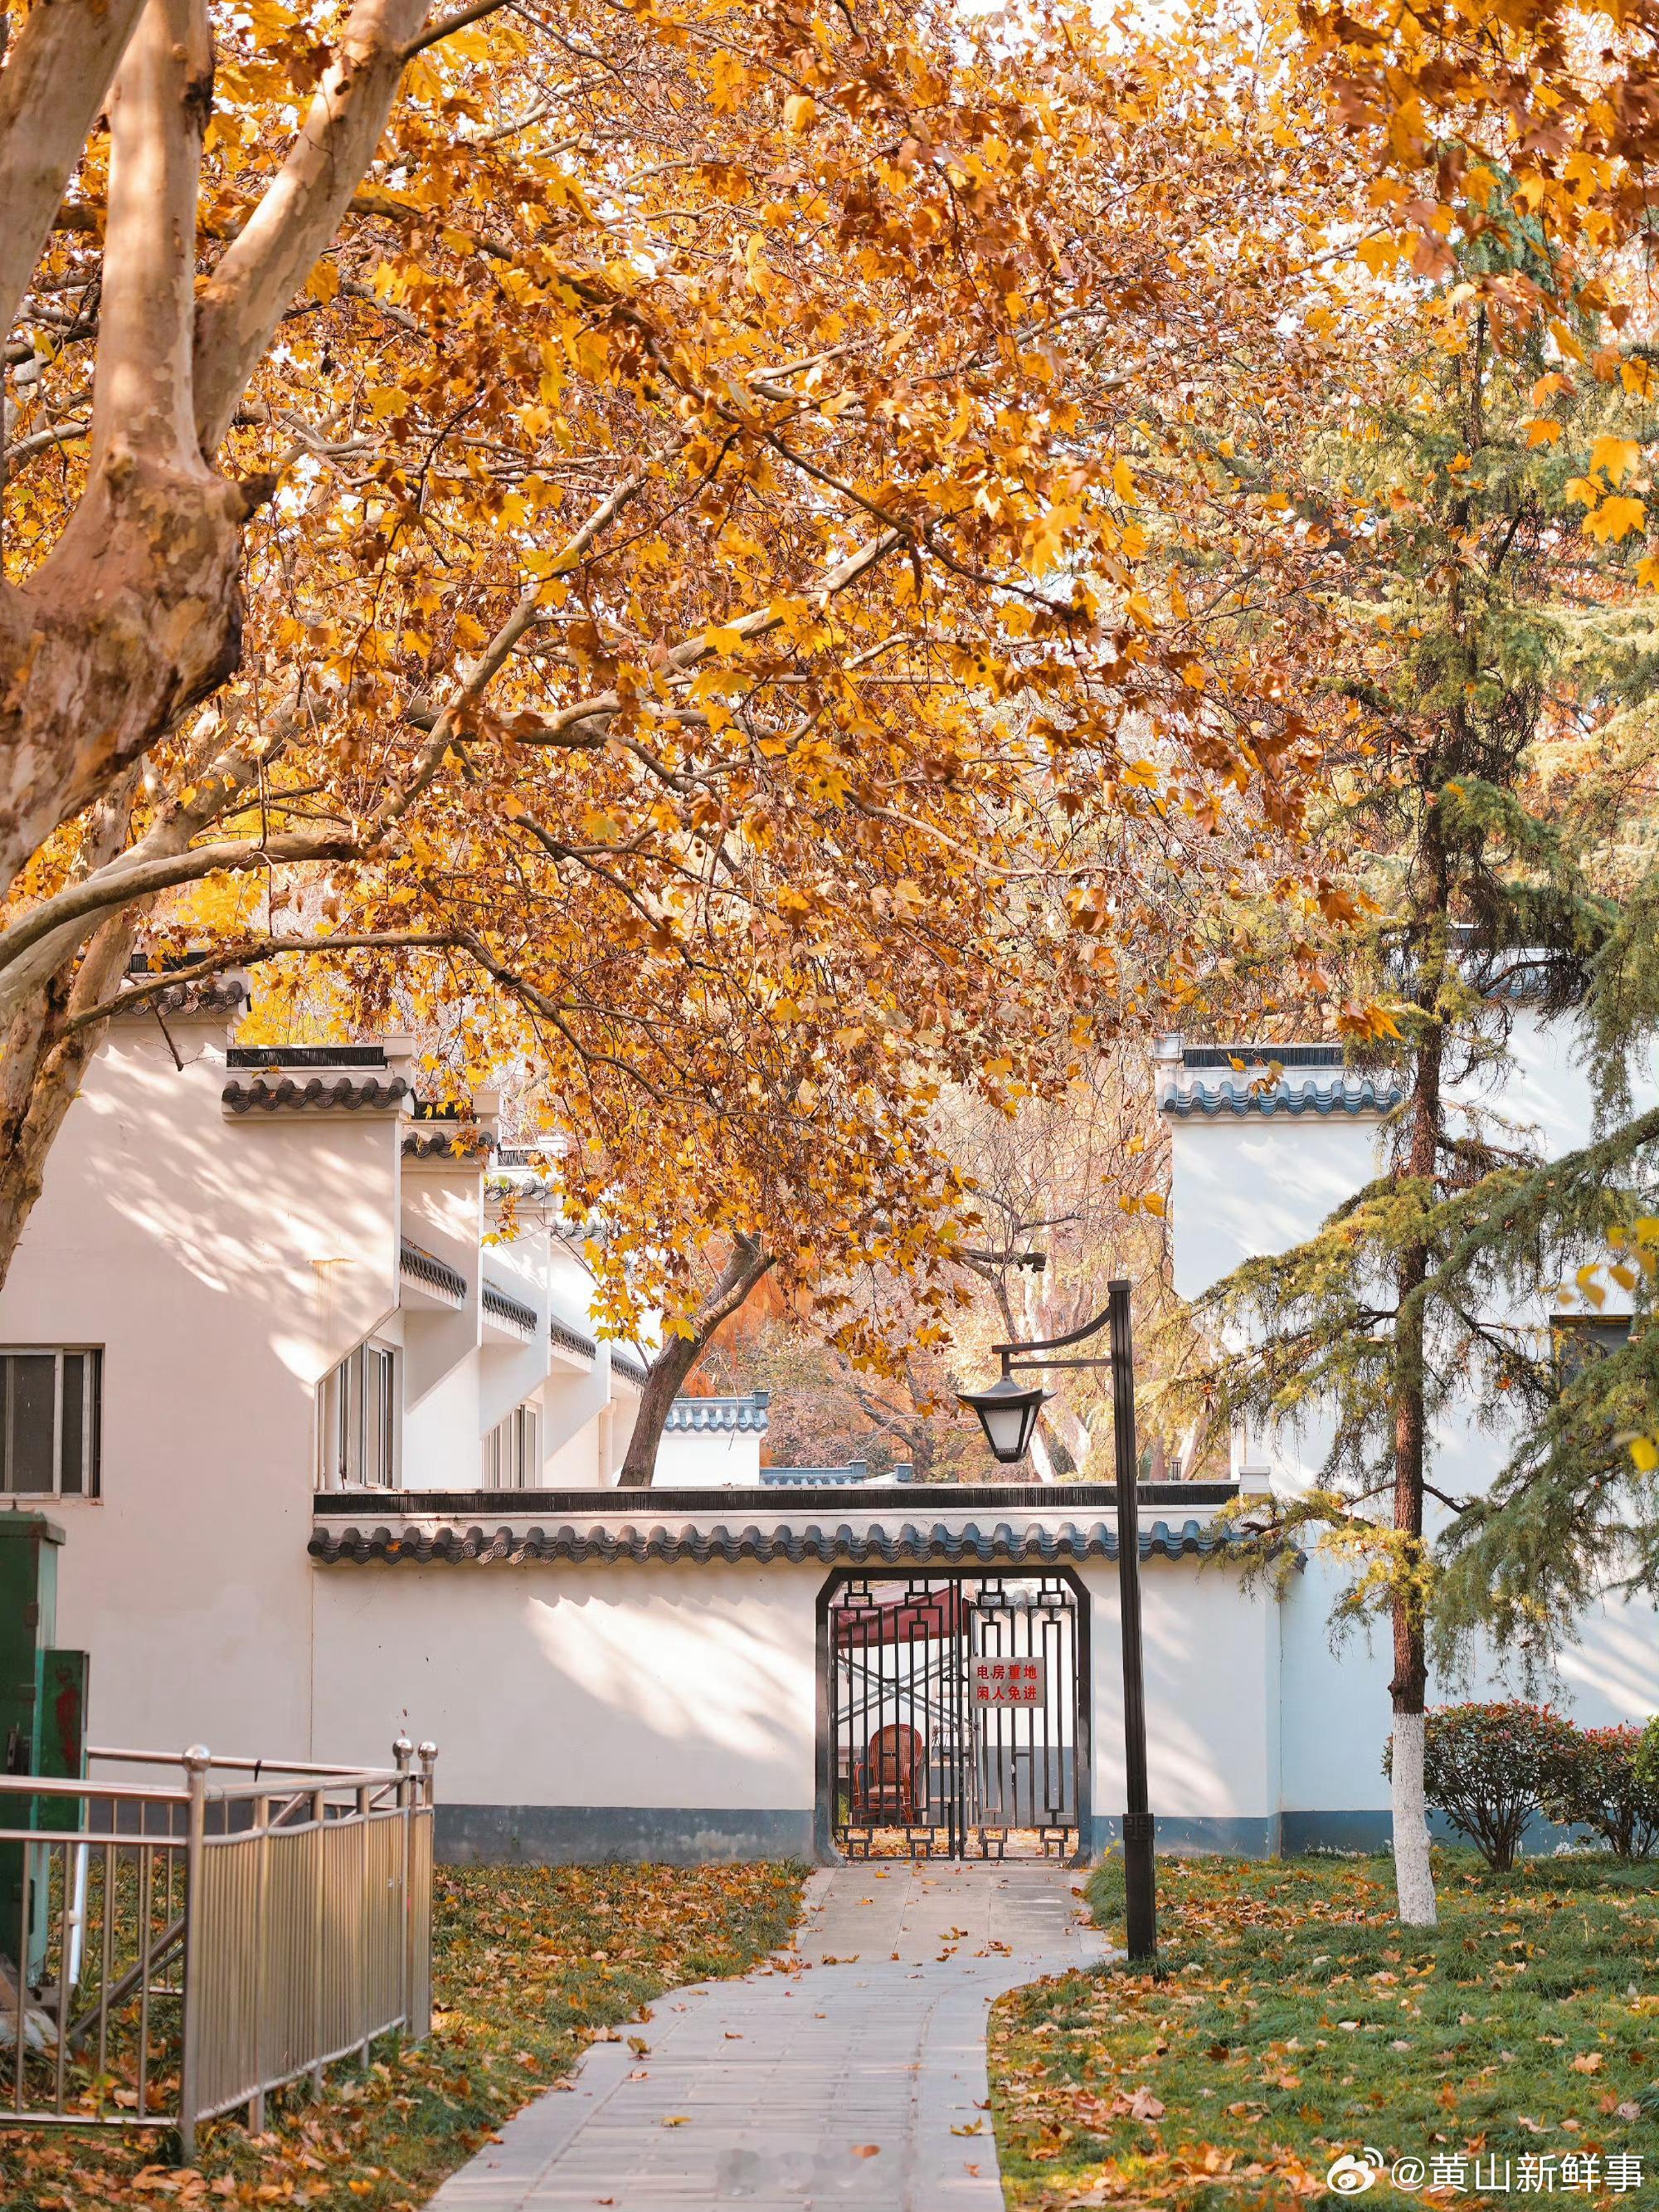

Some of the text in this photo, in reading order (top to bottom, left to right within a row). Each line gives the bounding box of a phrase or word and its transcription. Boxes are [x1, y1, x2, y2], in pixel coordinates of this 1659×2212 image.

[977, 1664, 1037, 1679] 电房重地
[977, 1686, 1036, 1700] 闲人免进
